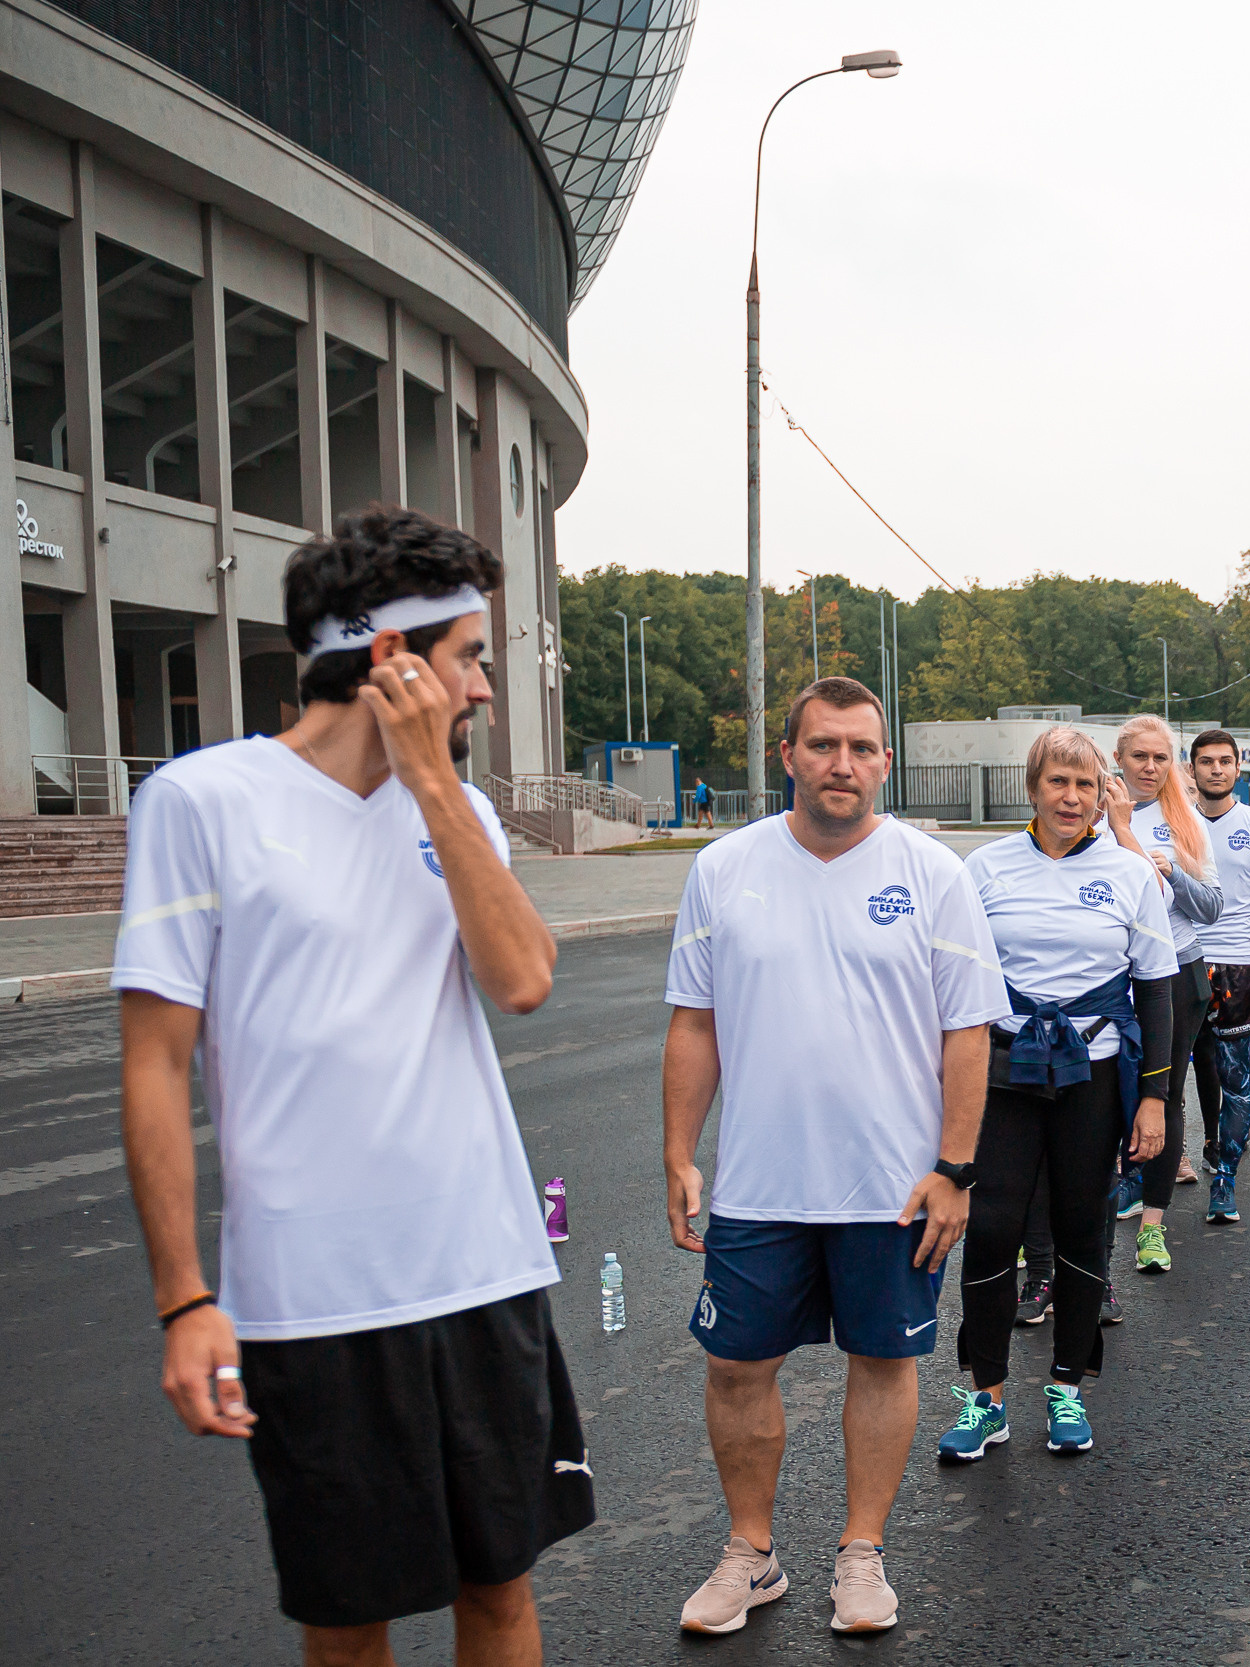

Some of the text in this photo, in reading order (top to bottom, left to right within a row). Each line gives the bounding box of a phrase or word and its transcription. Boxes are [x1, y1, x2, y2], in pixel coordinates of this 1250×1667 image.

[1079, 886, 1112, 897] ДИНАМО
[867, 895, 911, 906] ДИНАМО
[1087, 892, 1115, 905] БЕЖИТ
[879, 904, 915, 915] БЕЖИТ
